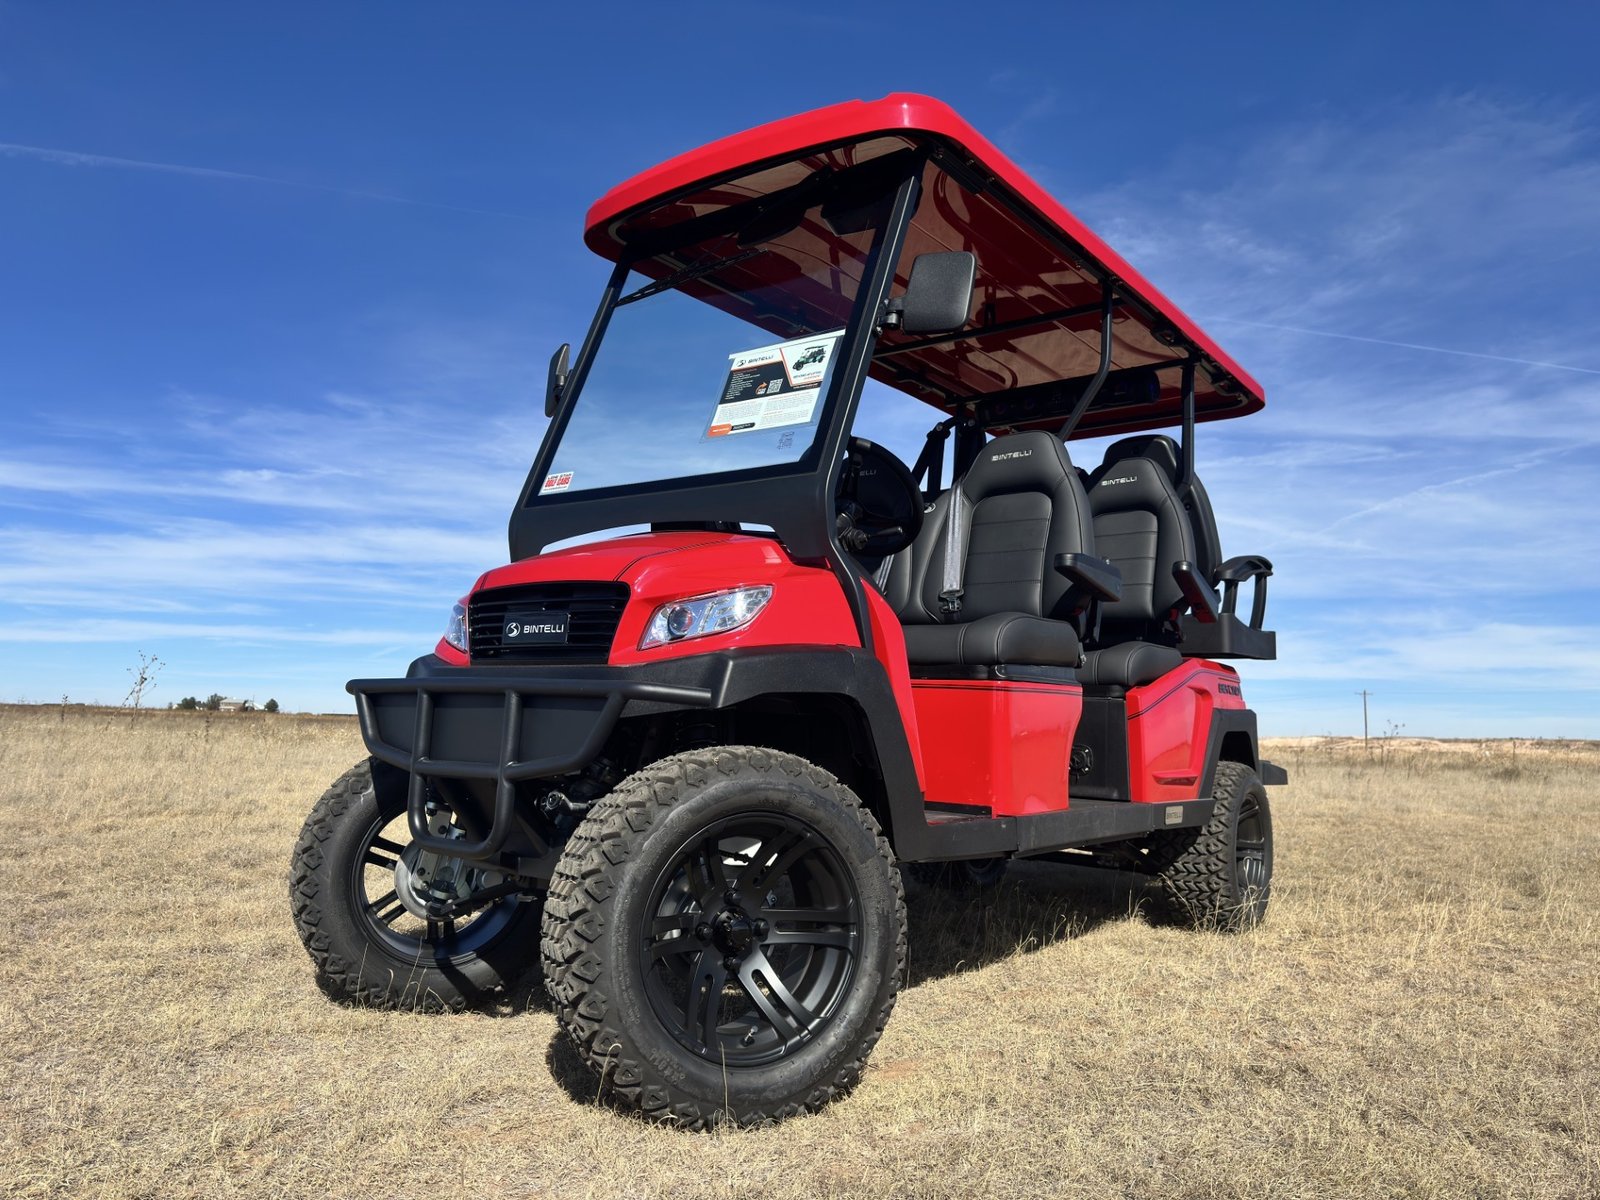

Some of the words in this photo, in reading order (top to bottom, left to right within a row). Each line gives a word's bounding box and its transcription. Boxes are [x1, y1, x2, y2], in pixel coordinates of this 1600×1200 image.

[991, 449, 1033, 461] BINTELLI
[1101, 476, 1138, 486] BINTELLI
[523, 624, 565, 634] BINTELLI
